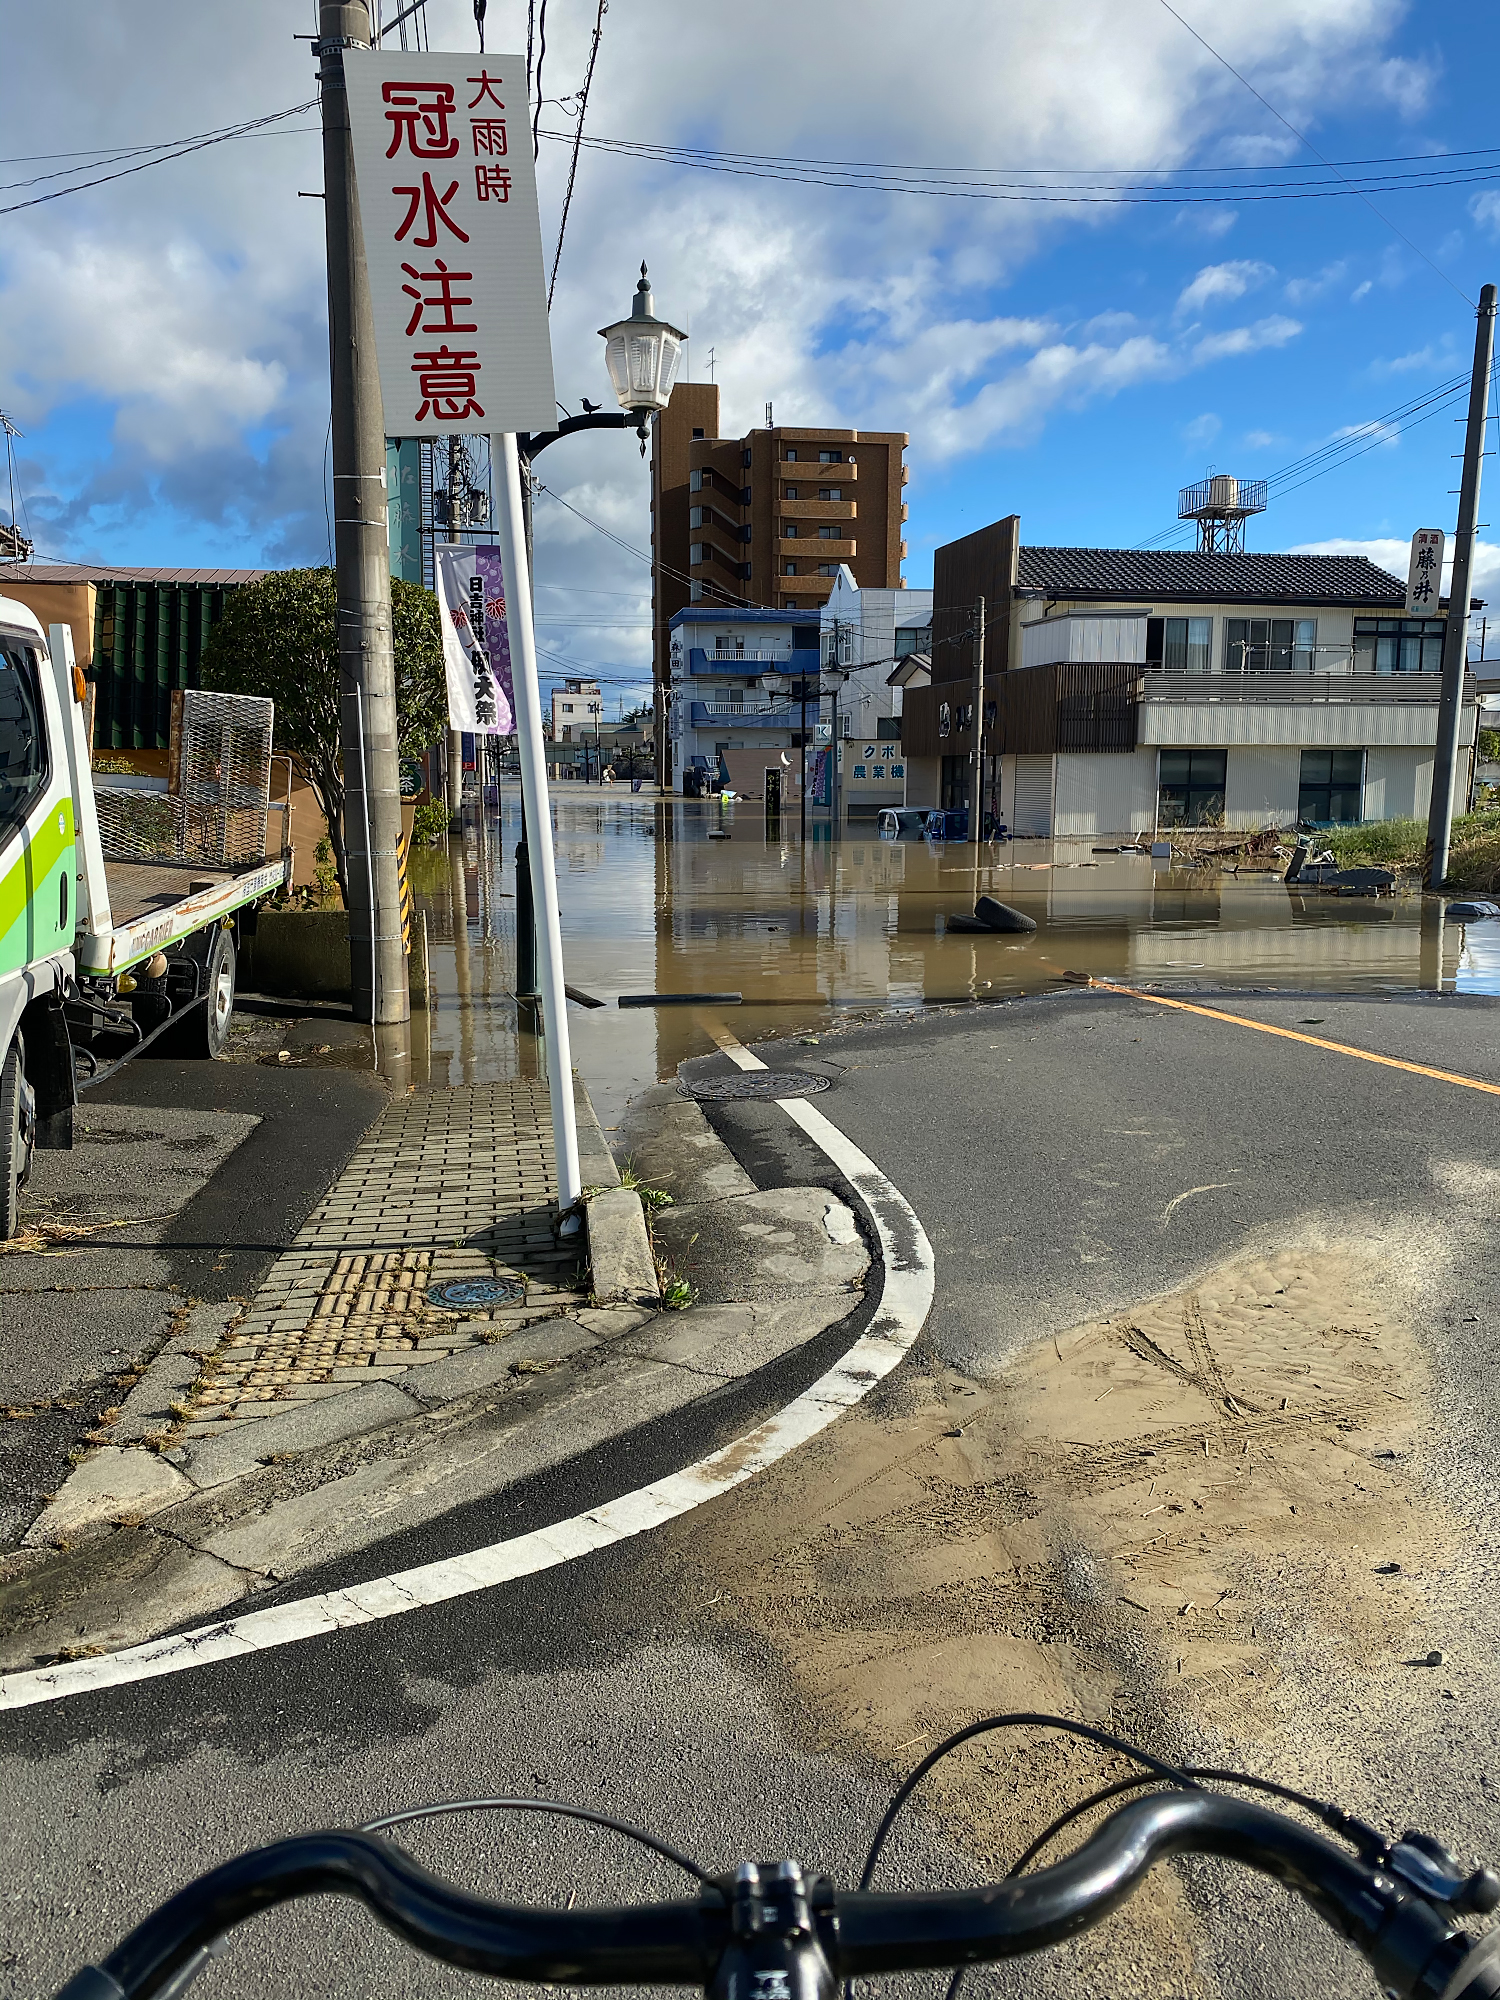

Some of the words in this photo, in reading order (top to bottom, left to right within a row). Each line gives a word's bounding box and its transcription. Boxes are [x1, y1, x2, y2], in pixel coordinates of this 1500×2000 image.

[466, 69, 512, 203] 大雨時
[381, 81, 486, 421] 冠水注意
[1418, 533, 1439, 544] 清酒
[1413, 547, 1437, 604] 藤乃井
[469, 576, 485, 642] 日吉神社
[671, 642, 680, 701] 森田ビル
[853, 765, 904, 779] 農業機
[864, 745, 905, 760] クボ
[400, 776, 415, 793] 茶
